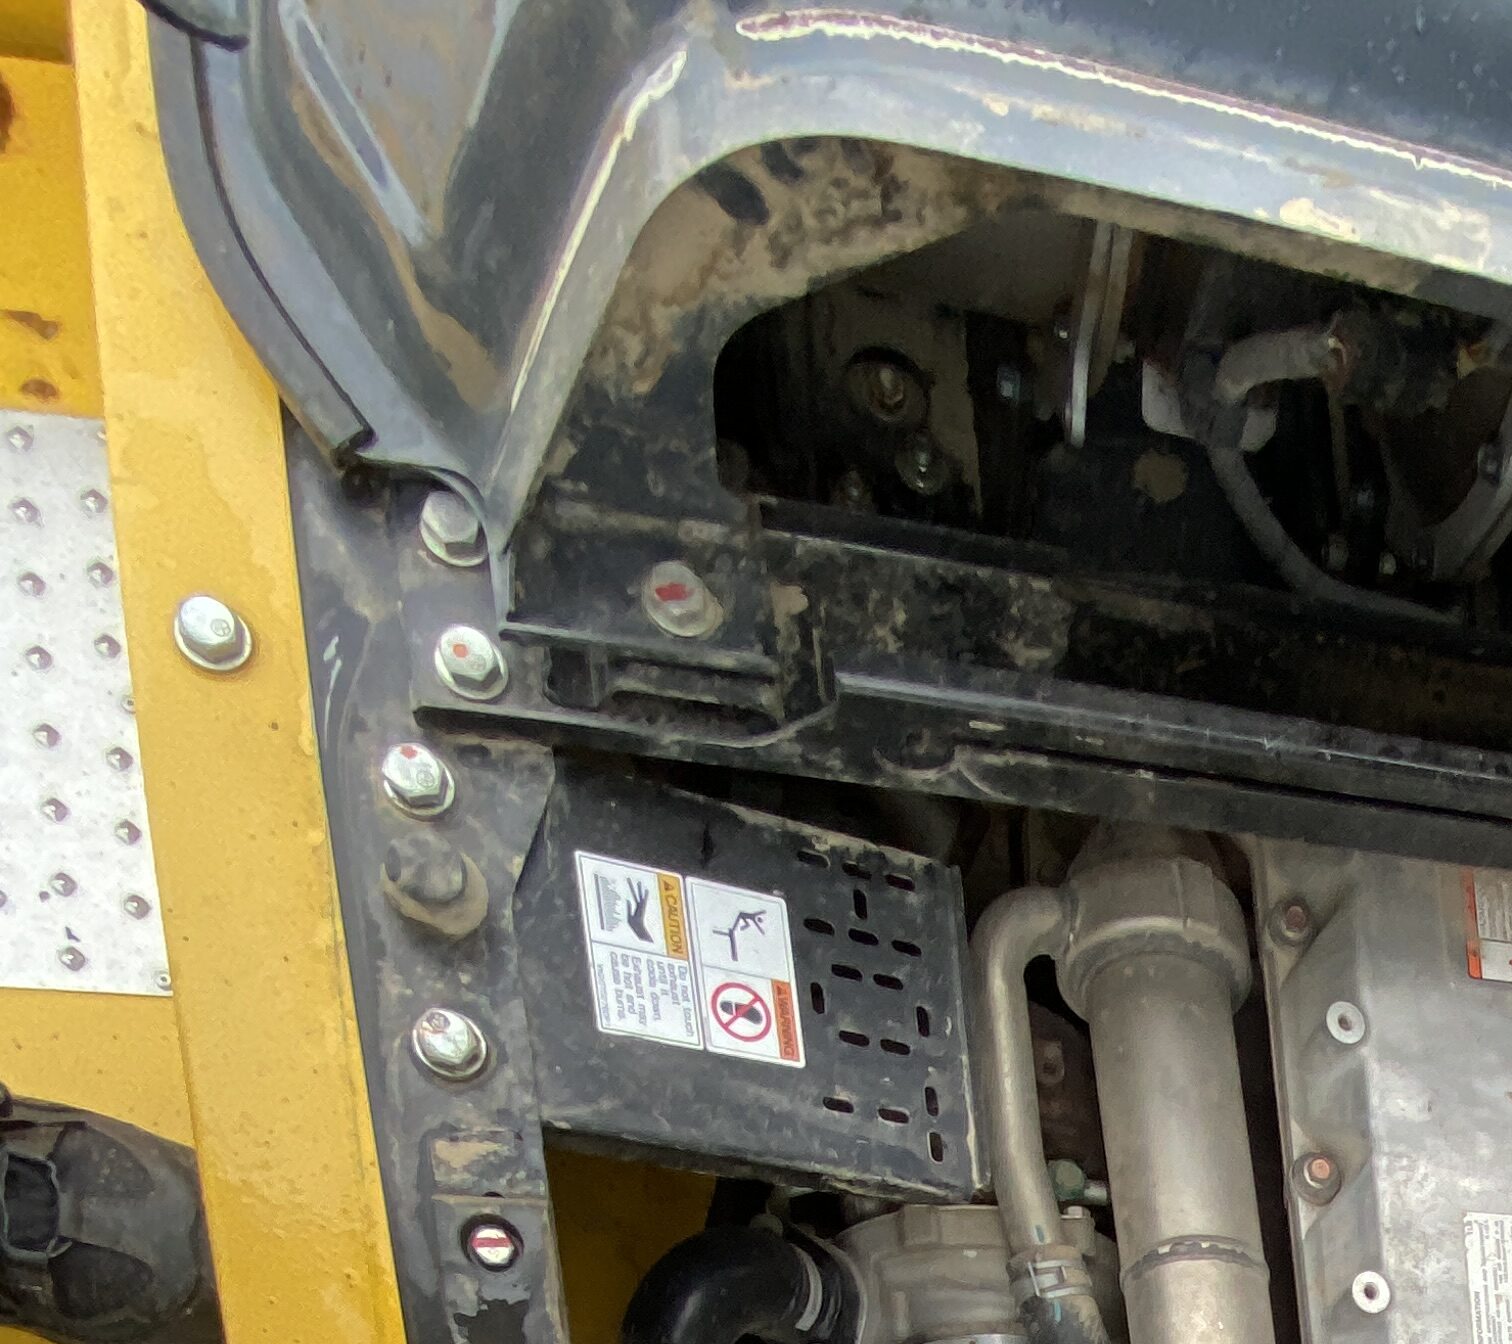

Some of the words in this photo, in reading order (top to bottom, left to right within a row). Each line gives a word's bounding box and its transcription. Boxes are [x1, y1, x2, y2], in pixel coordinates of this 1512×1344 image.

[665, 894, 683, 954] CAUTION
[610, 951, 621, 985] cause
[621, 953, 631, 967] be
[623, 972, 633, 990] hot
[632, 956, 644, 999] Exhaust
[656, 961, 667, 985] until
[677, 965, 688, 980] Do
[659, 988, 669, 996] it
[667, 963, 680, 1006] exhaust
[680, 985, 690, 1002] not
[626, 994, 637, 1015] and
[636, 1004, 647, 1026] may
[683, 1007, 695, 1037] touch
[778, 995, 796, 1058] WARNING
